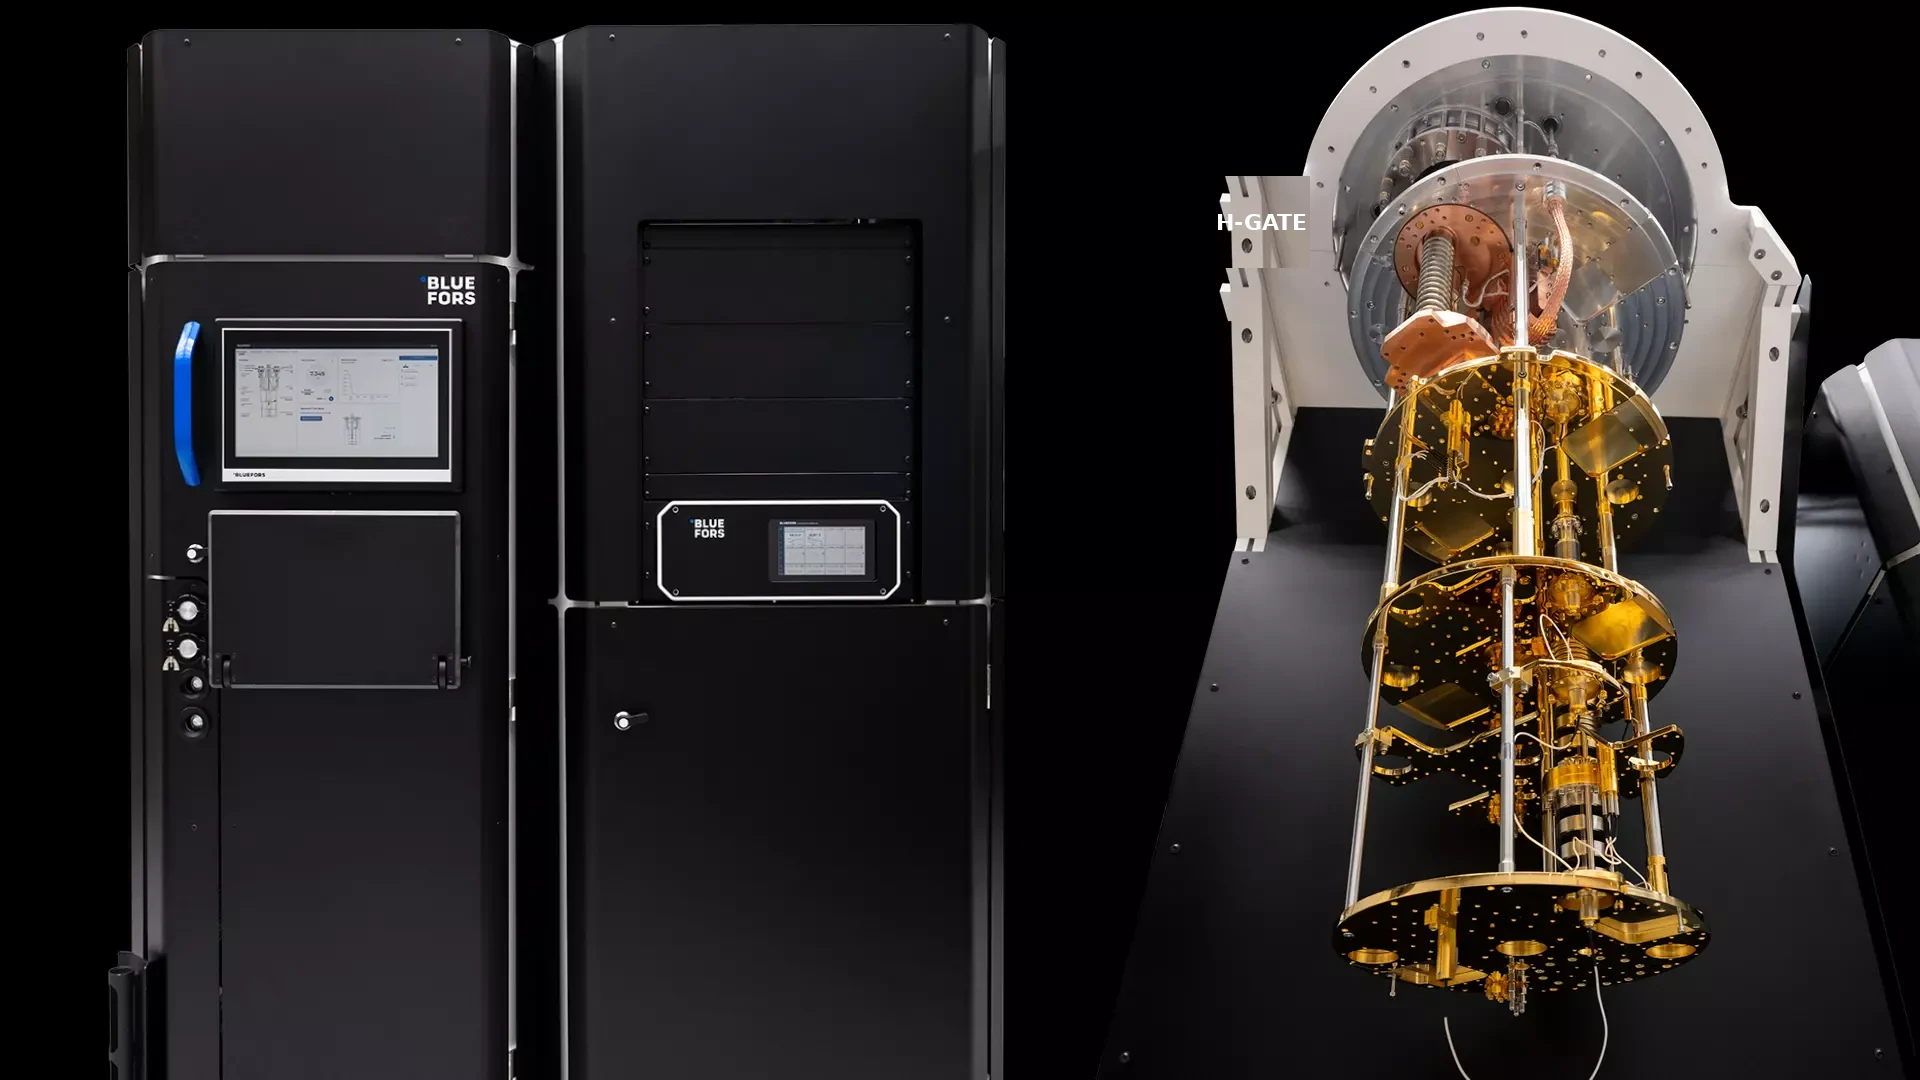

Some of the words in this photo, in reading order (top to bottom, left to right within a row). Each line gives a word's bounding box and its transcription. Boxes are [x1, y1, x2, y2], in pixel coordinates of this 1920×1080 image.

[427, 276, 475, 290] BLUE
[427, 291, 476, 305] FORS
[694, 519, 725, 528] BLUE
[694, 529, 725, 538] FORS
